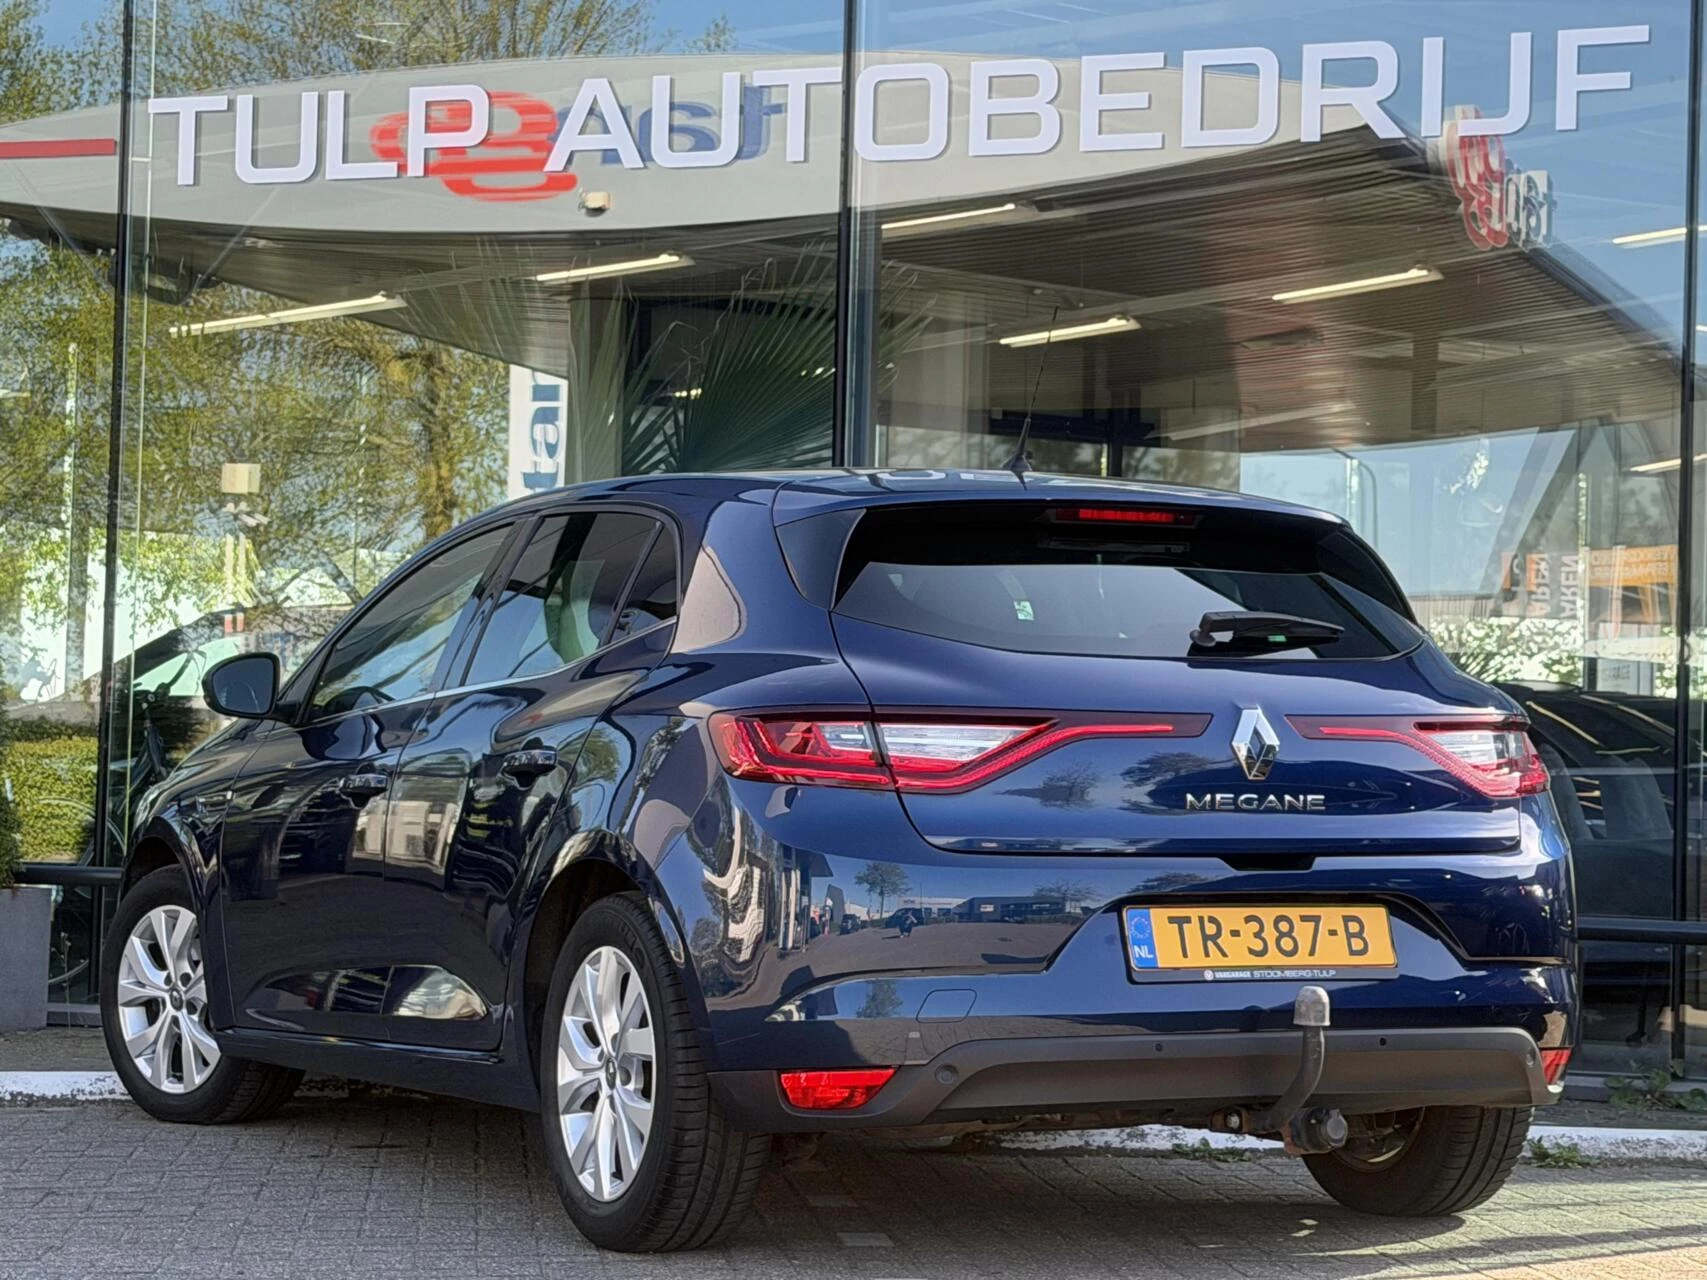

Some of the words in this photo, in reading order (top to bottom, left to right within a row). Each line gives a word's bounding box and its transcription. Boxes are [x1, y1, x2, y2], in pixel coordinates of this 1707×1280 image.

[147, 85, 490, 186] TULP
[544, 25, 1651, 172] AUTOBEDRIJF
[1185, 793, 1326, 811] MEGANE
[1134, 945, 1154, 959] NL
[1167, 914, 1370, 959] TR-387-B
